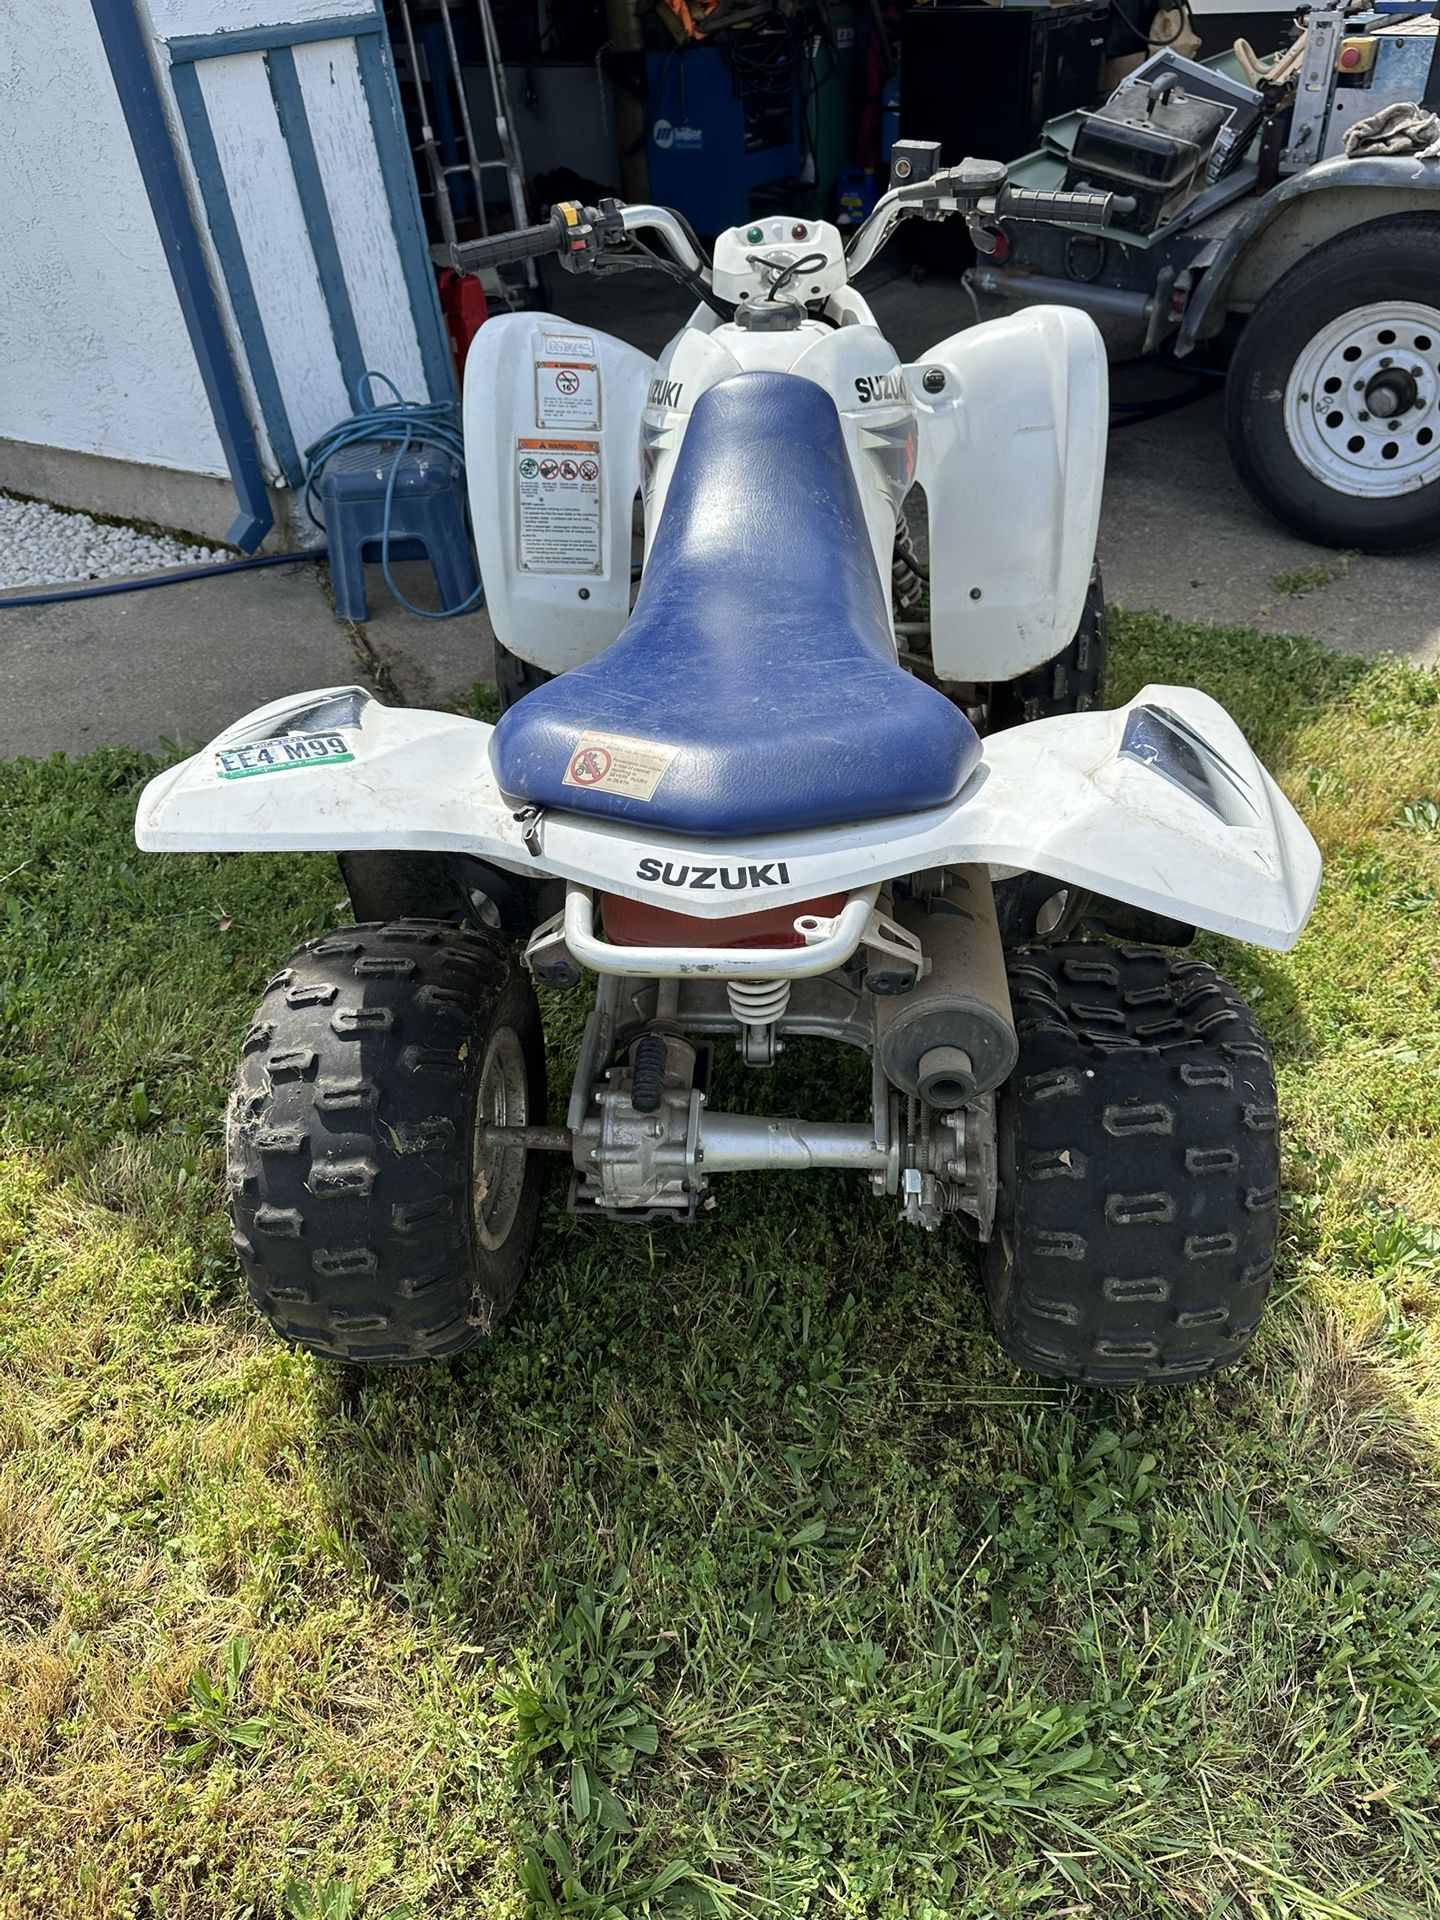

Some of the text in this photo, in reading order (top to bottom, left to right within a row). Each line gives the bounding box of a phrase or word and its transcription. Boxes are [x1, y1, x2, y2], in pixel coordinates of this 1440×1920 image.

[562, 384, 572, 392] 16
[220, 748, 275, 772] EE4
[283, 737, 349, 760] M99
[636, 857, 791, 890] SUZUKI
